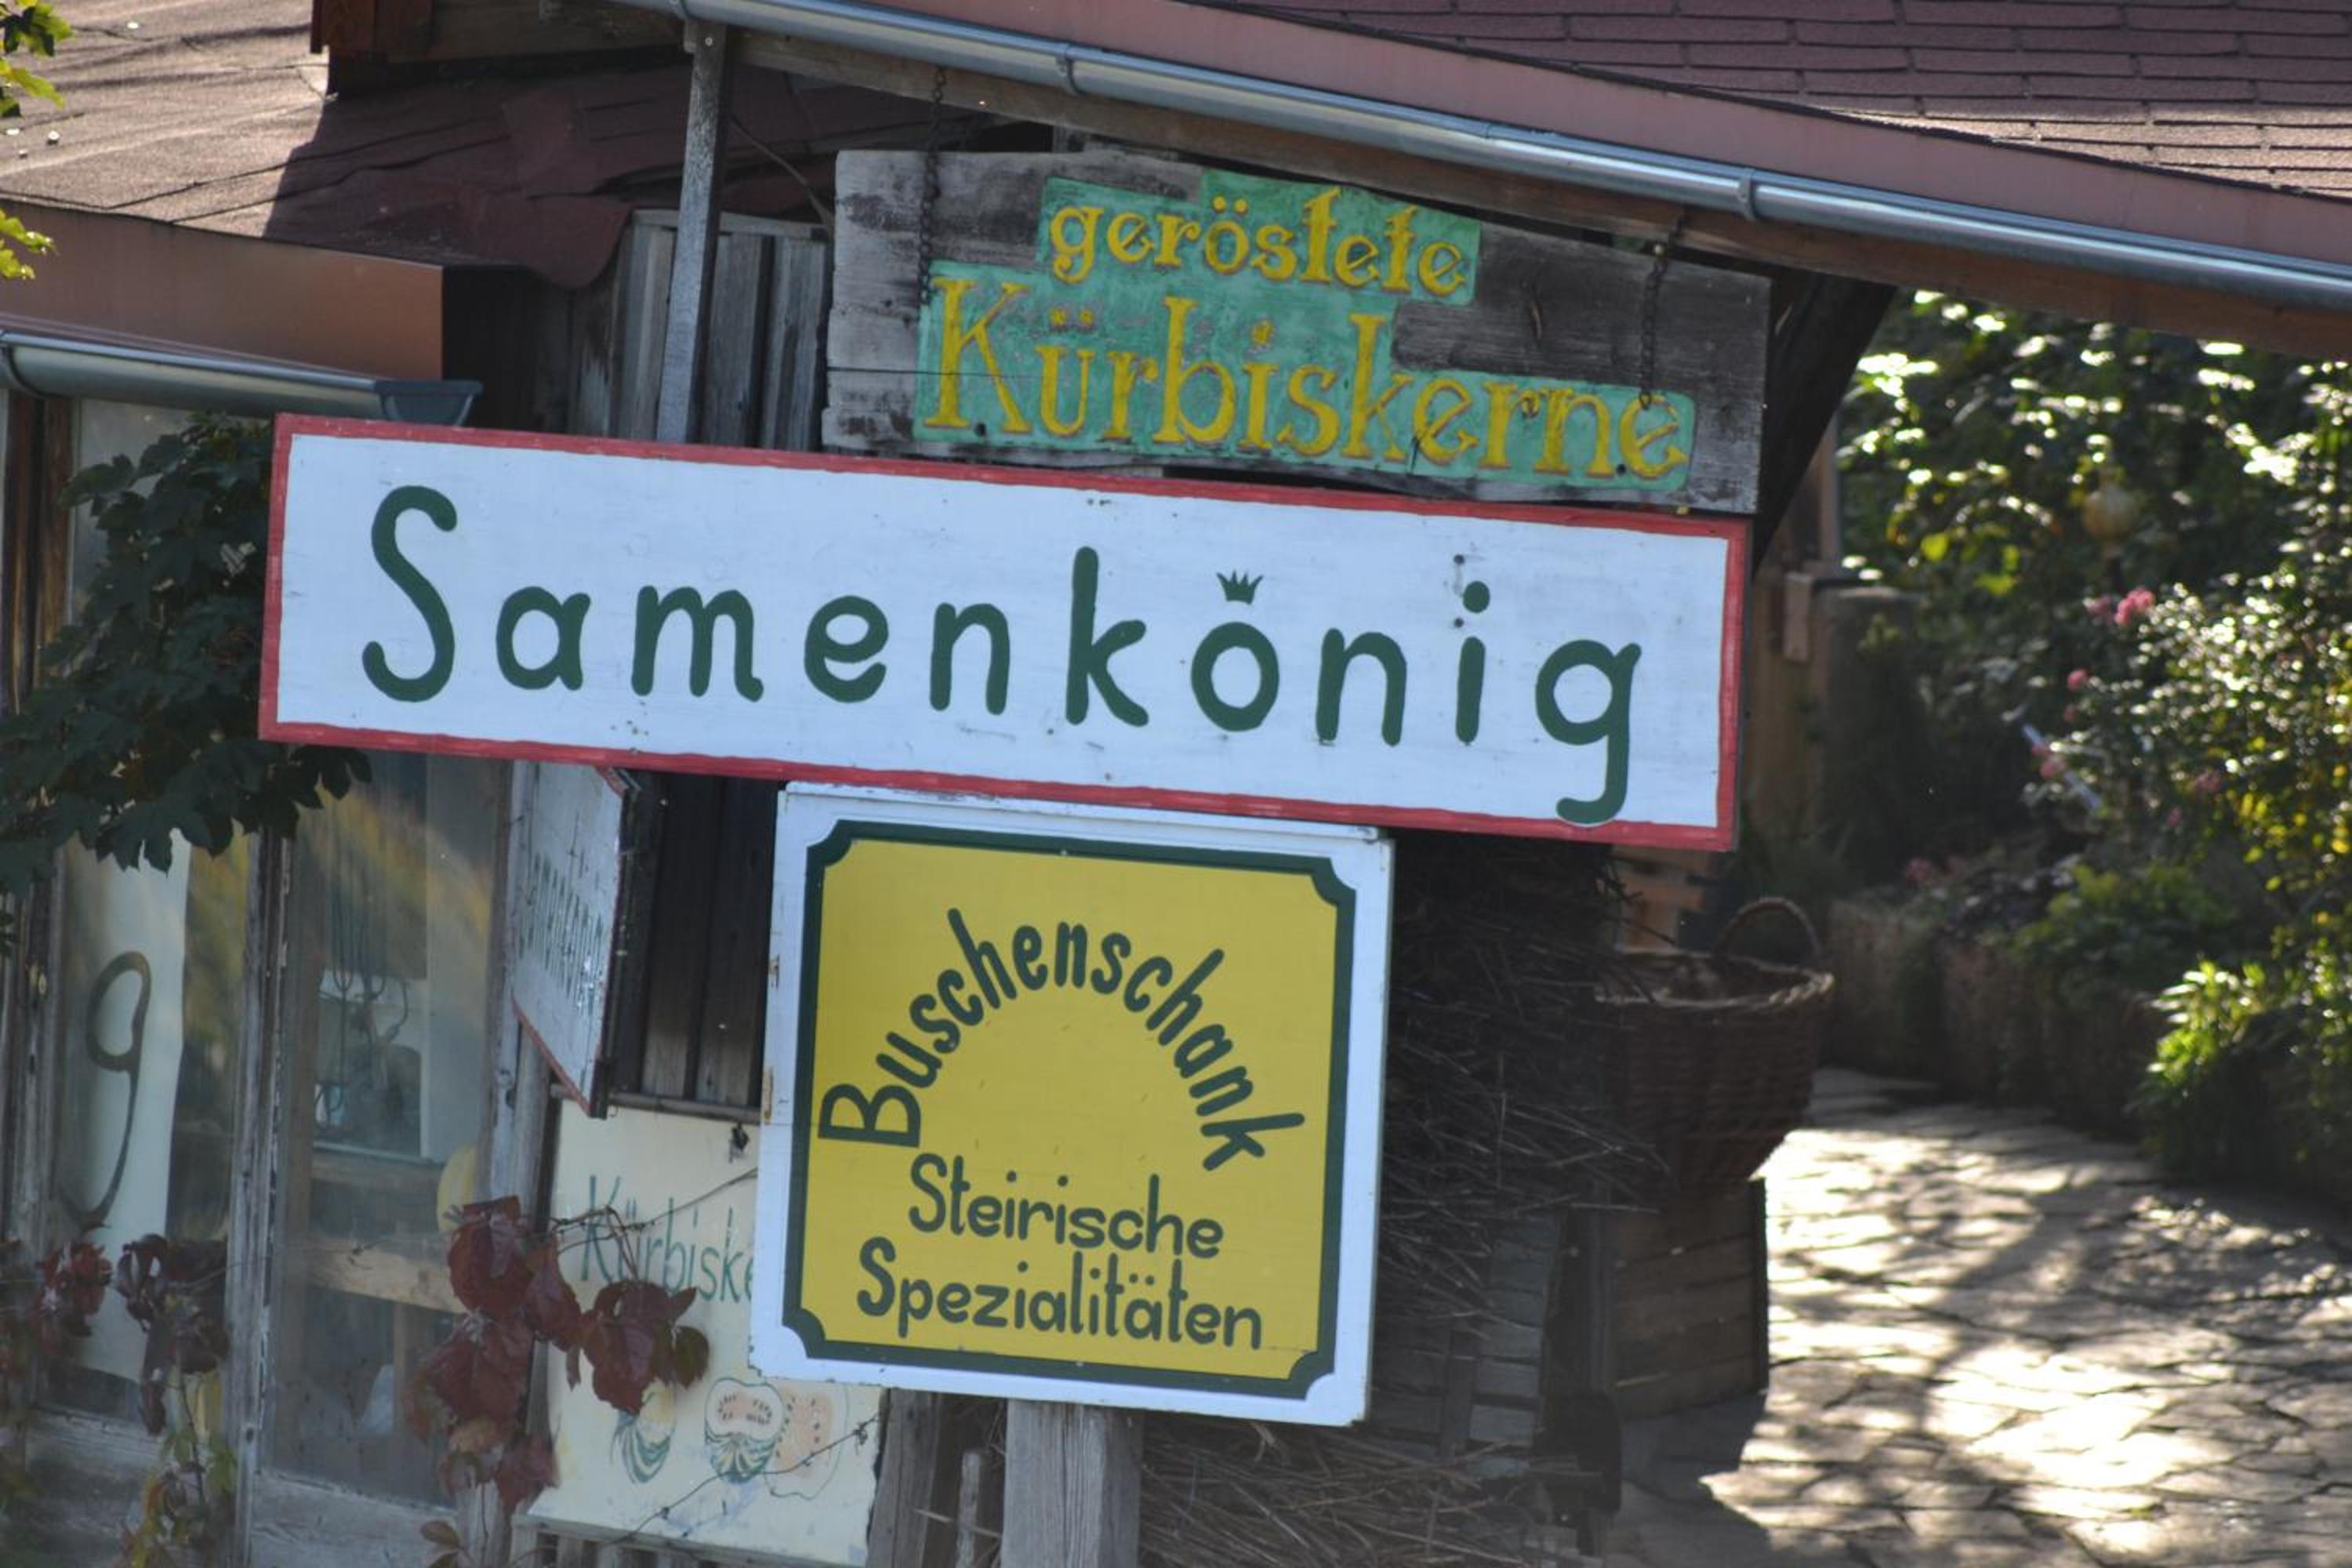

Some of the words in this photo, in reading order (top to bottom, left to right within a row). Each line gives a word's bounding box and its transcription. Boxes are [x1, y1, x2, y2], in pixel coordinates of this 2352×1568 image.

[1051, 187, 1465, 297] geröstete
[924, 277, 1687, 479] Kürbiskerne
[817, 907, 1306, 1172] Buschenschank
[908, 1152, 1225, 1260] Steirische
[856, 1236, 1263, 1351] Spezialitäten
